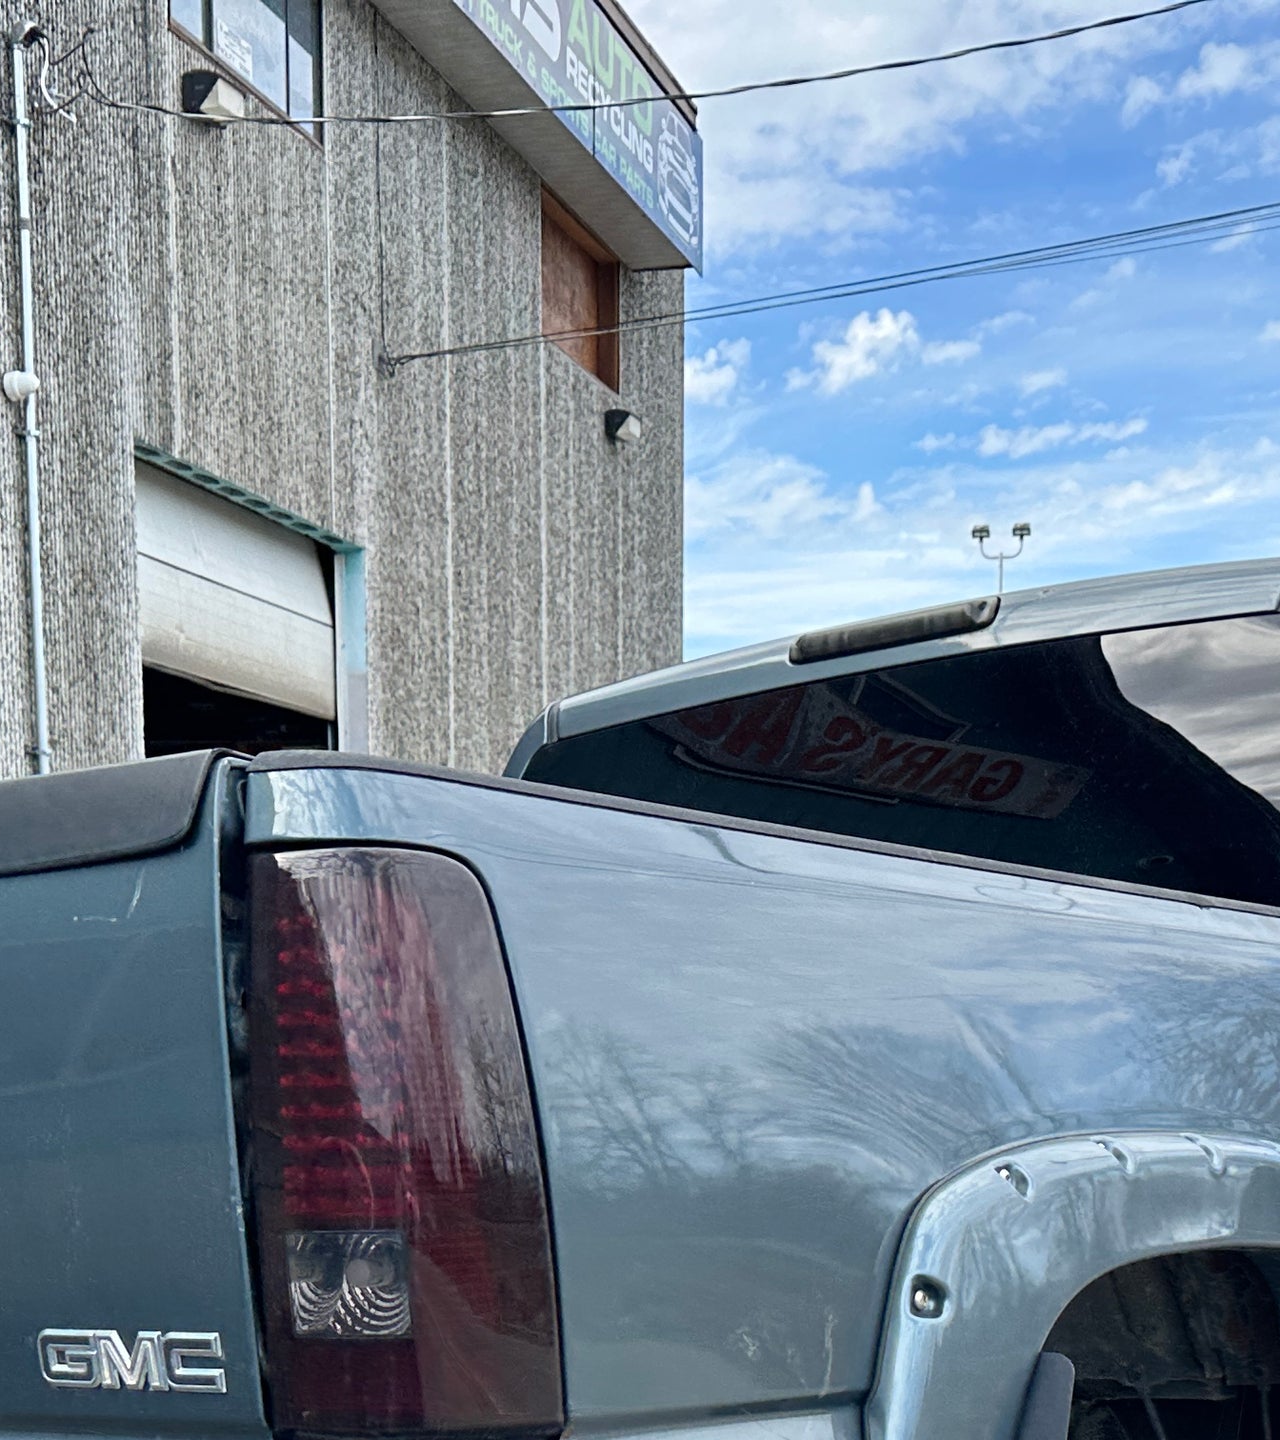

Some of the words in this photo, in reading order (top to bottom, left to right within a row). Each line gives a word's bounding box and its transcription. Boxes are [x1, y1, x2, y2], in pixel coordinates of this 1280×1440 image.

[477, 0, 523, 65] TRUCK
[541, 66, 589, 138] SPORTS
[595, 130, 617, 166] CAR
[620, 153, 654, 209] PARTS
[566, 46, 654, 175] RECYCLING
[567, 0, 653, 137] AUTO
[37, 1328, 228, 1394] GMC
